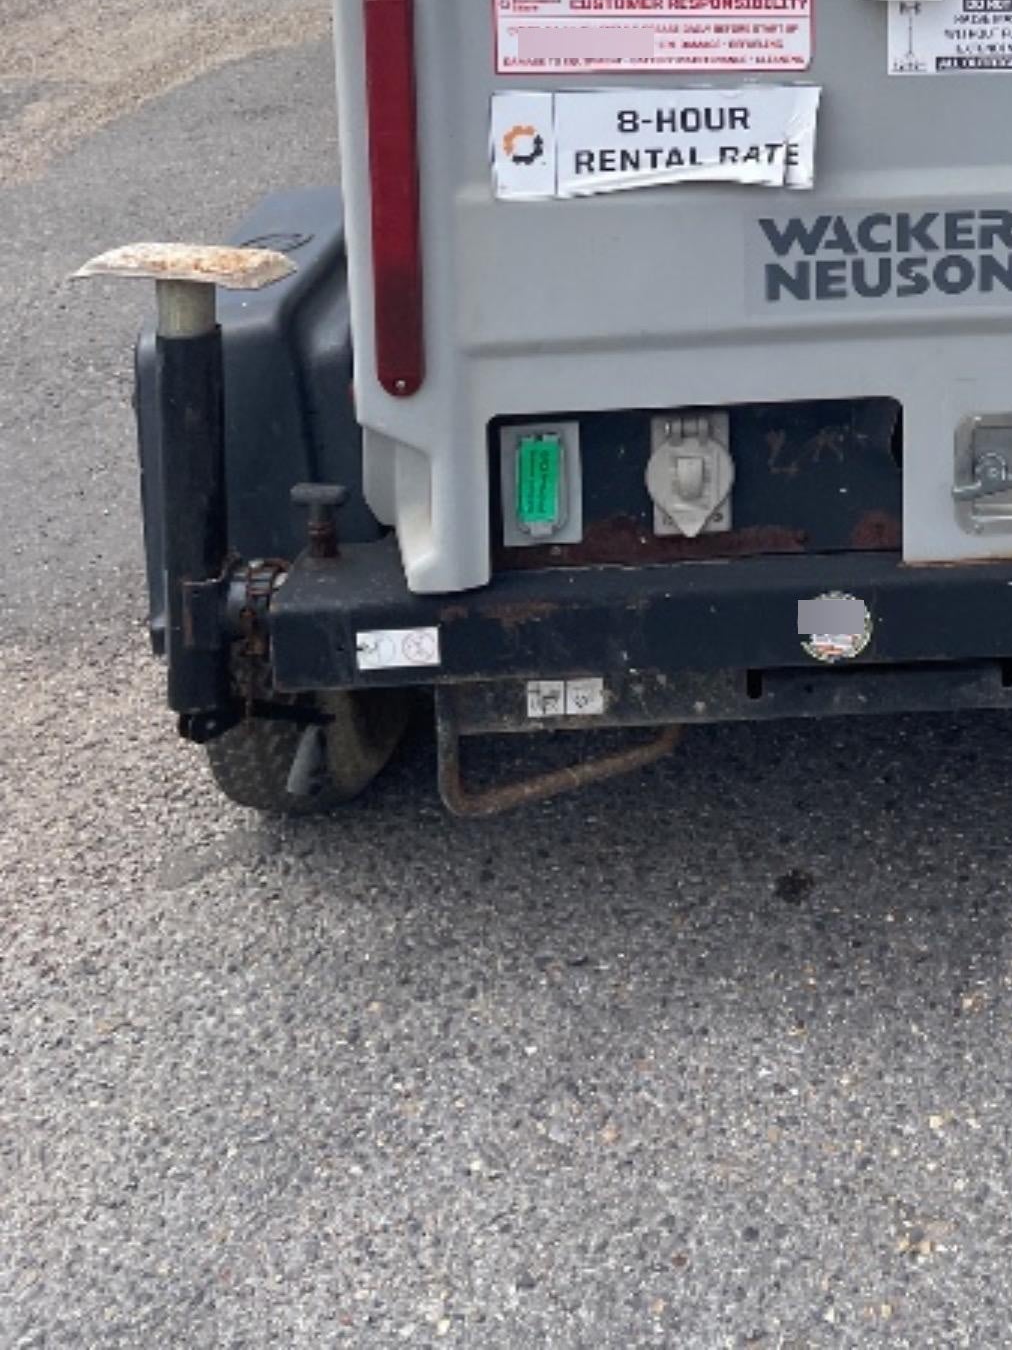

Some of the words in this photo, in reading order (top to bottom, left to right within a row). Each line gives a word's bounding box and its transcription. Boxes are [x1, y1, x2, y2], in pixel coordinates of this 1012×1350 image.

[616, 106, 751, 133] 8-HOUR
[574, 145, 703, 175] RENTAL
[718, 142, 800, 167] RATE
